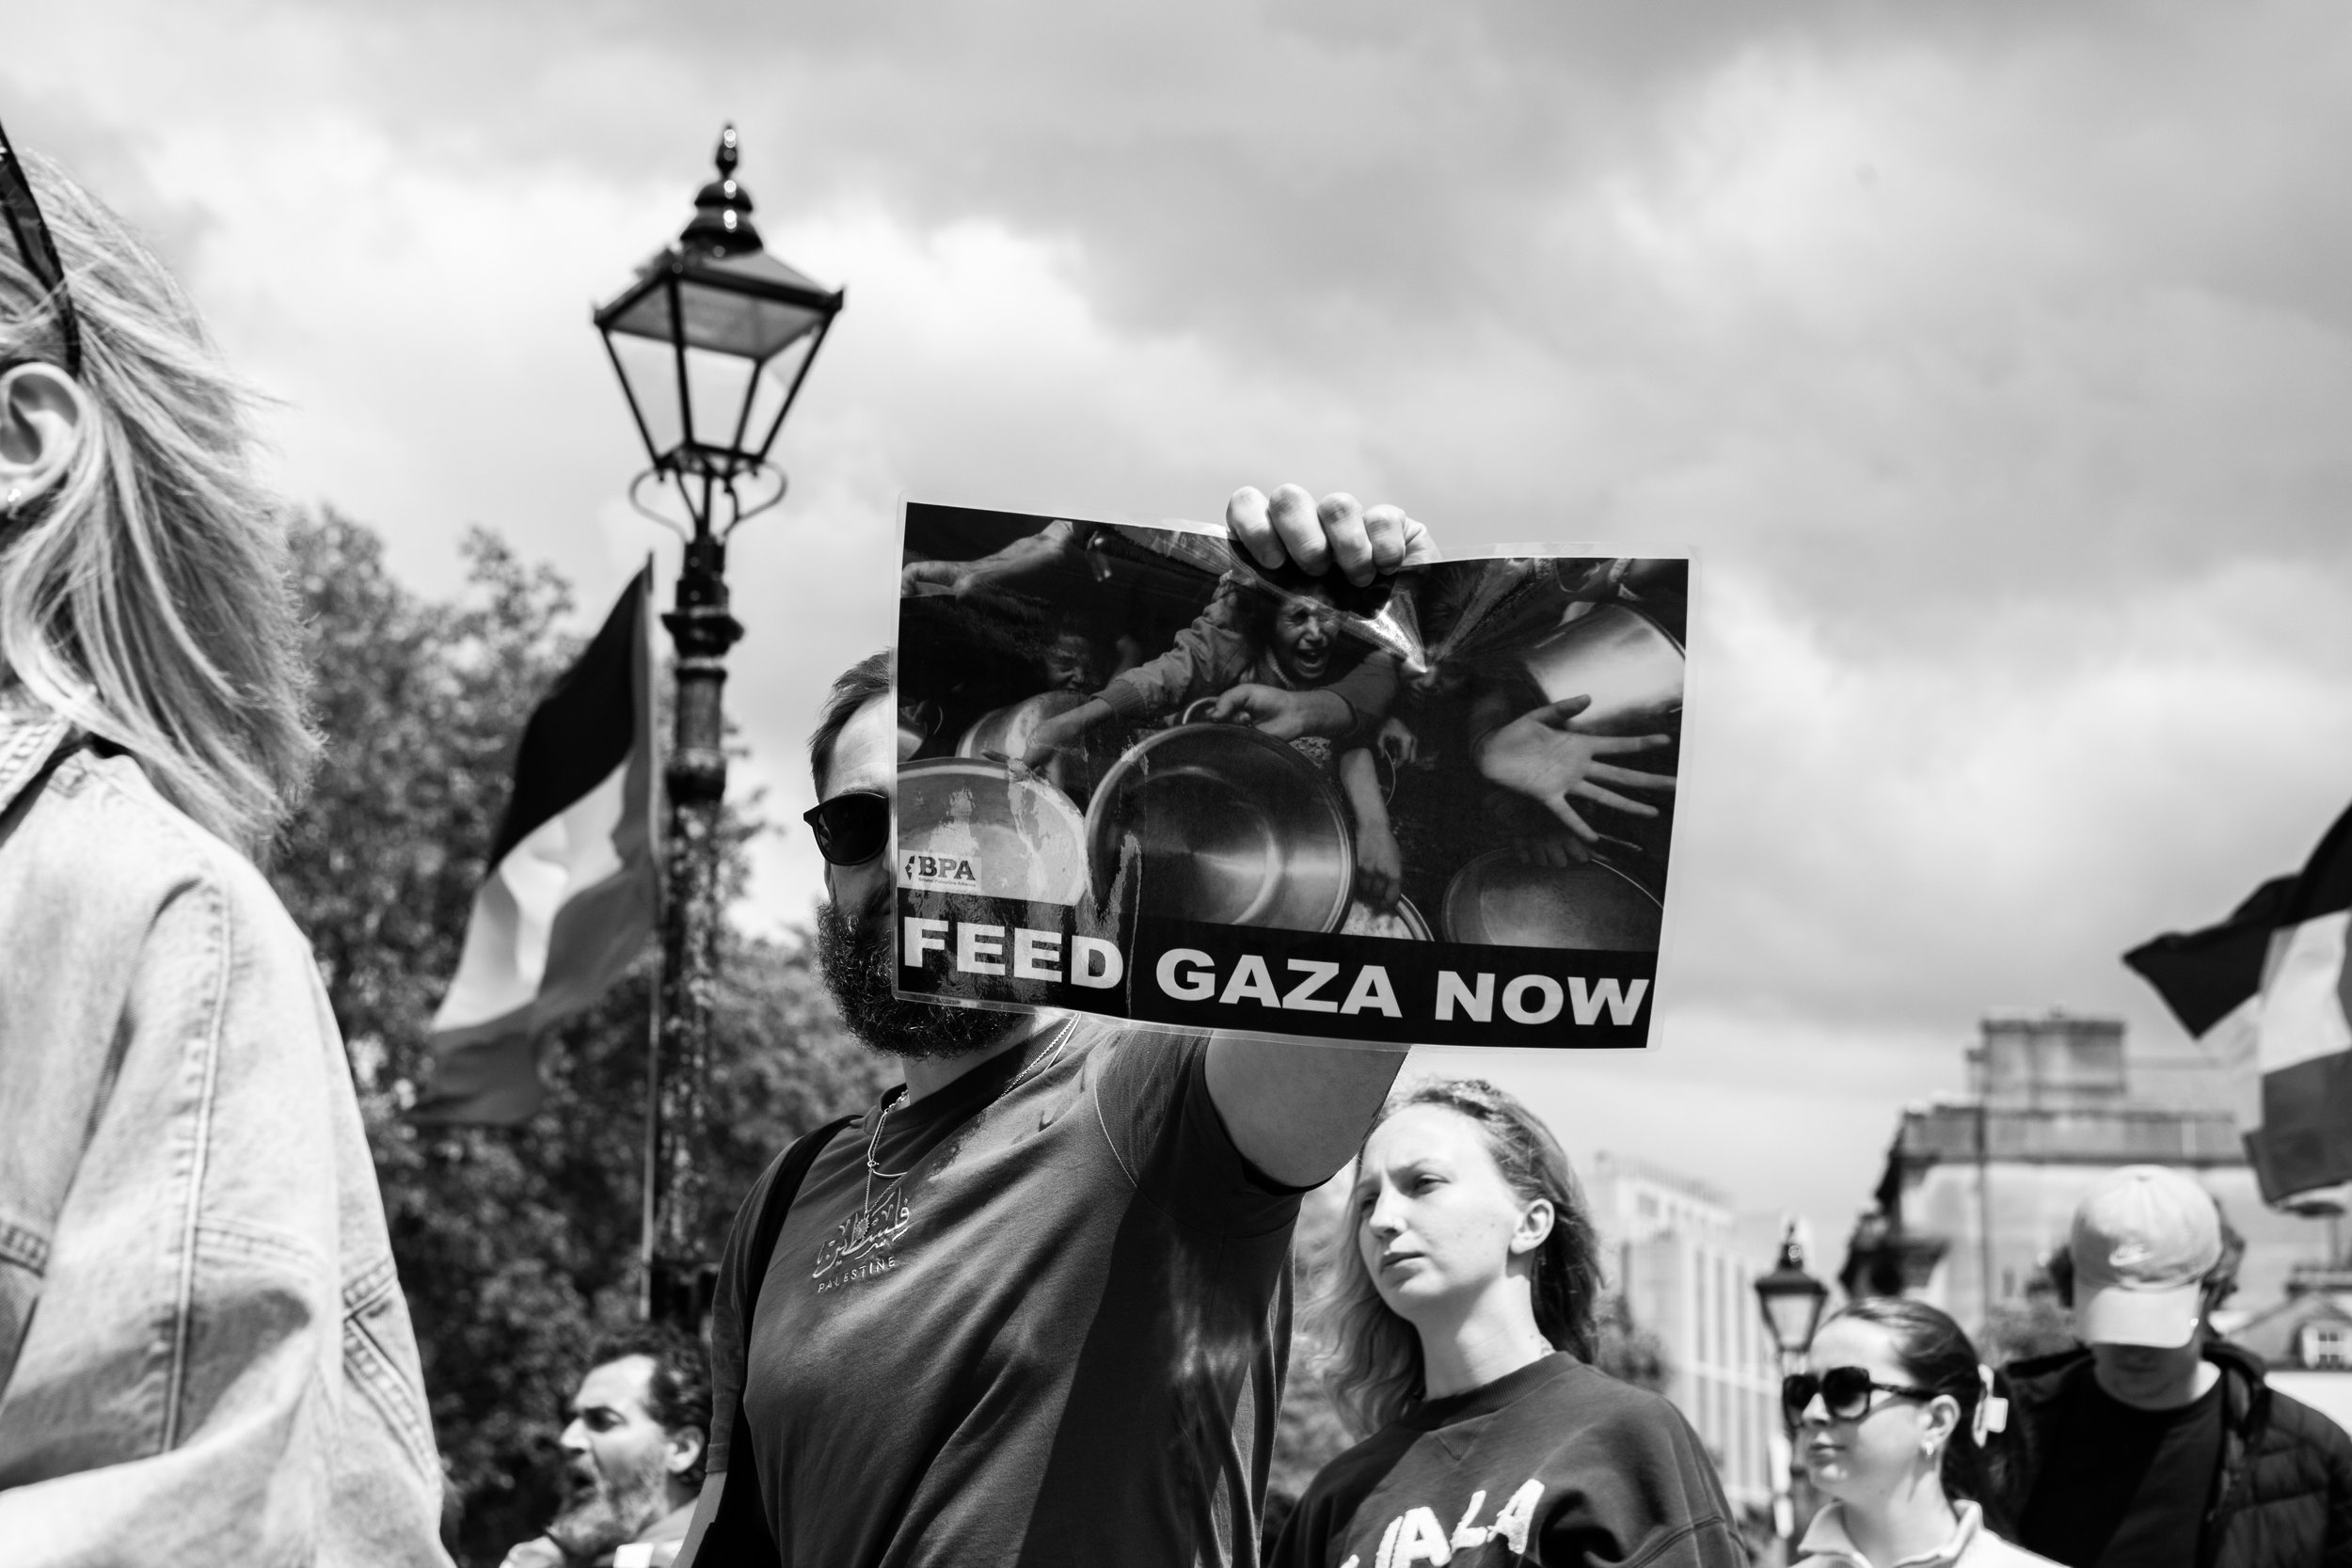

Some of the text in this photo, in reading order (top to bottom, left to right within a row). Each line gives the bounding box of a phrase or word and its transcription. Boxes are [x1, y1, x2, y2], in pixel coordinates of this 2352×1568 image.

[918, 855, 977, 881] BPA
[904, 916, 1650, 1026] FEED GAZA NOW
[817, 1257, 896, 1293] PALESTINE
